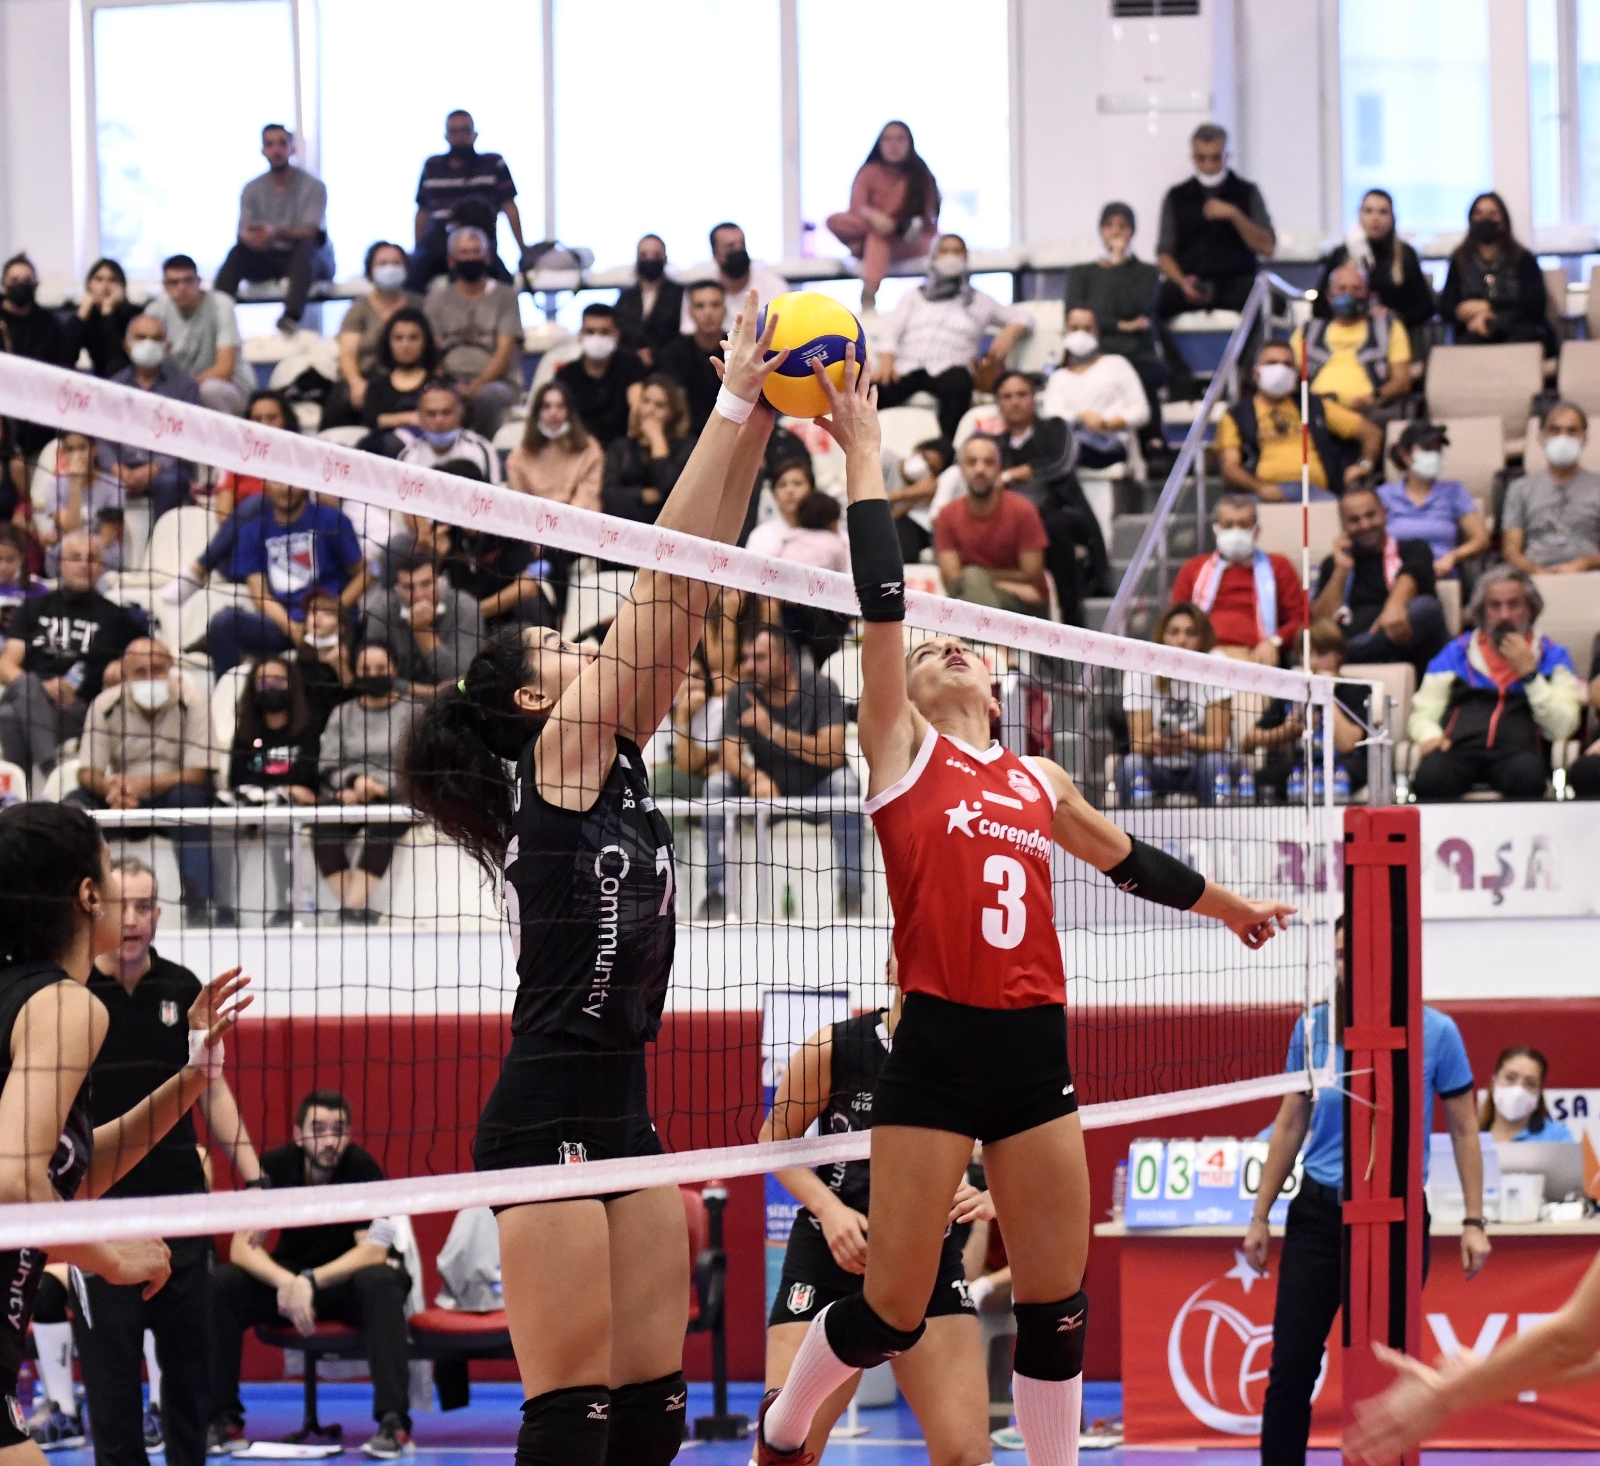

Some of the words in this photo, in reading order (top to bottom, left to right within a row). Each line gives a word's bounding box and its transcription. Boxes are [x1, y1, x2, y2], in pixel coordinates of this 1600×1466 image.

[804, 350, 829, 367] FIB
[74, 391, 90, 409] TVF
[167, 415, 184, 435] TVF
[253, 440, 269, 459] TVF
[333, 462, 350, 479] TVF
[409, 480, 424, 497] TVF
[479, 497, 493, 512] TVF
[545, 513, 559, 531] TVF
[607, 529, 619, 546] TVF
[663, 541, 676, 558] TVF
[717, 554, 729, 569] TVF
[978, 818, 1052, 857] corendon
[981, 854, 1027, 950] 3
[581, 844, 630, 1019] Community
[1207, 1149, 1225, 1170] 4
